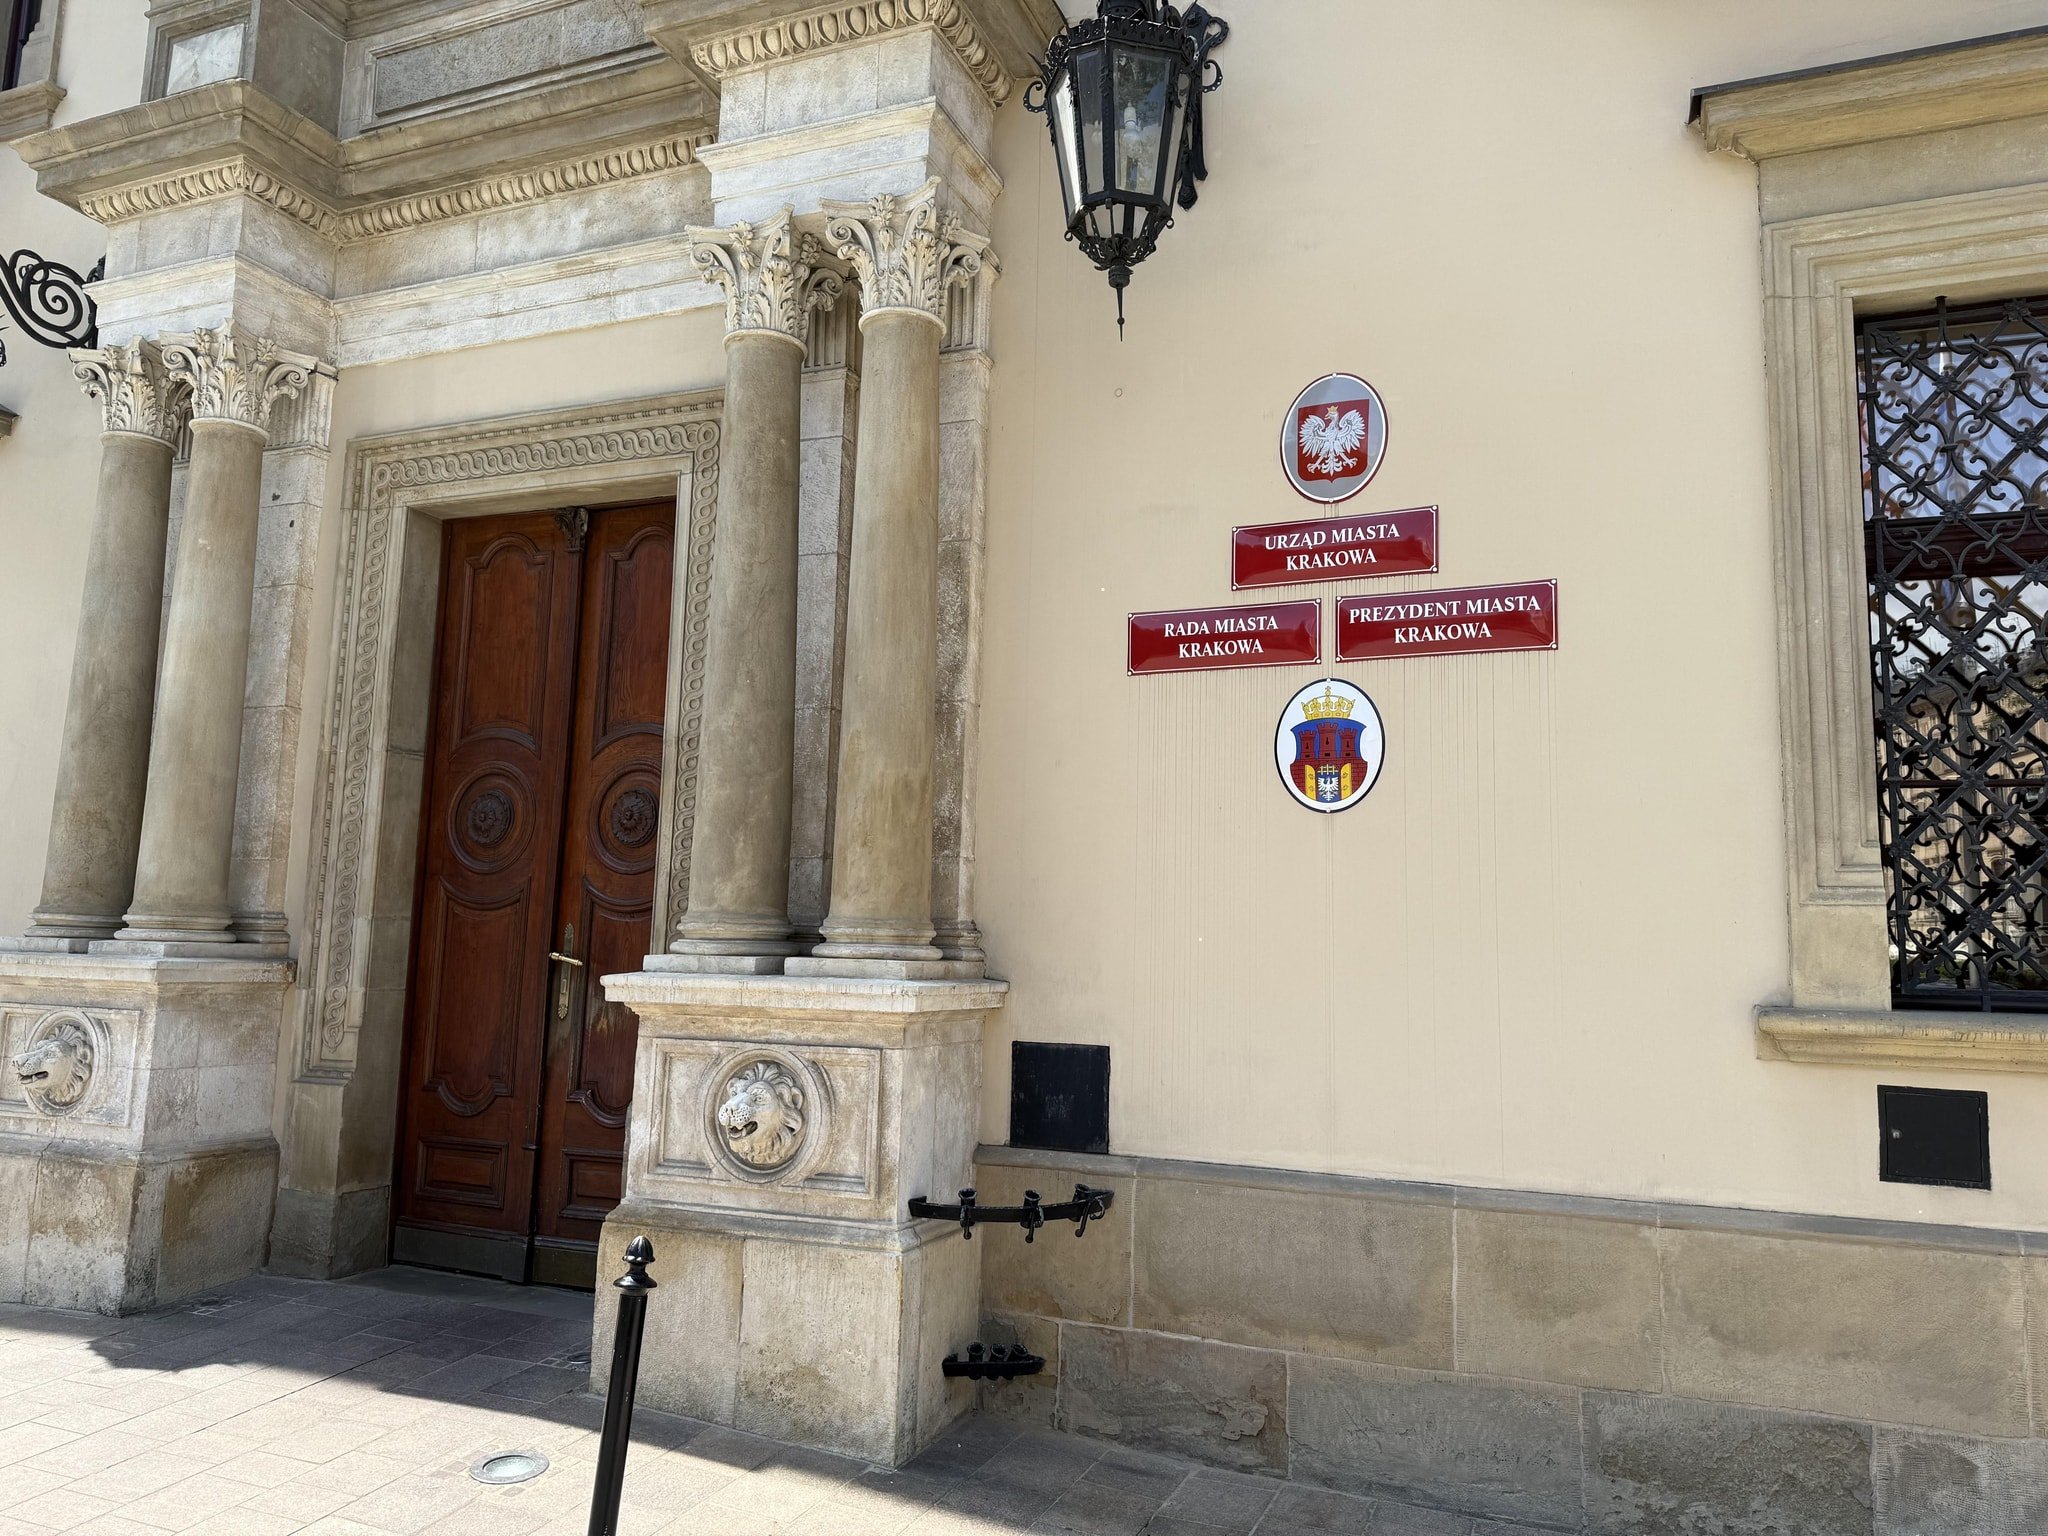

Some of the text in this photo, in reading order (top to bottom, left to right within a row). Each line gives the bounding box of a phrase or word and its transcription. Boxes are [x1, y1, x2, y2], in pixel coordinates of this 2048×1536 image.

[1264, 523, 1400, 550] URZĄD MIASTA
[1286, 548, 1377, 571] KRAKOWA
[1349, 595, 1541, 624] PREZYDENT MIASTA
[1164, 615, 1278, 638] RADA MIASTA
[1394, 622, 1492, 644] KRAKOWA
[1178, 638, 1264, 658] KRAKOWA
